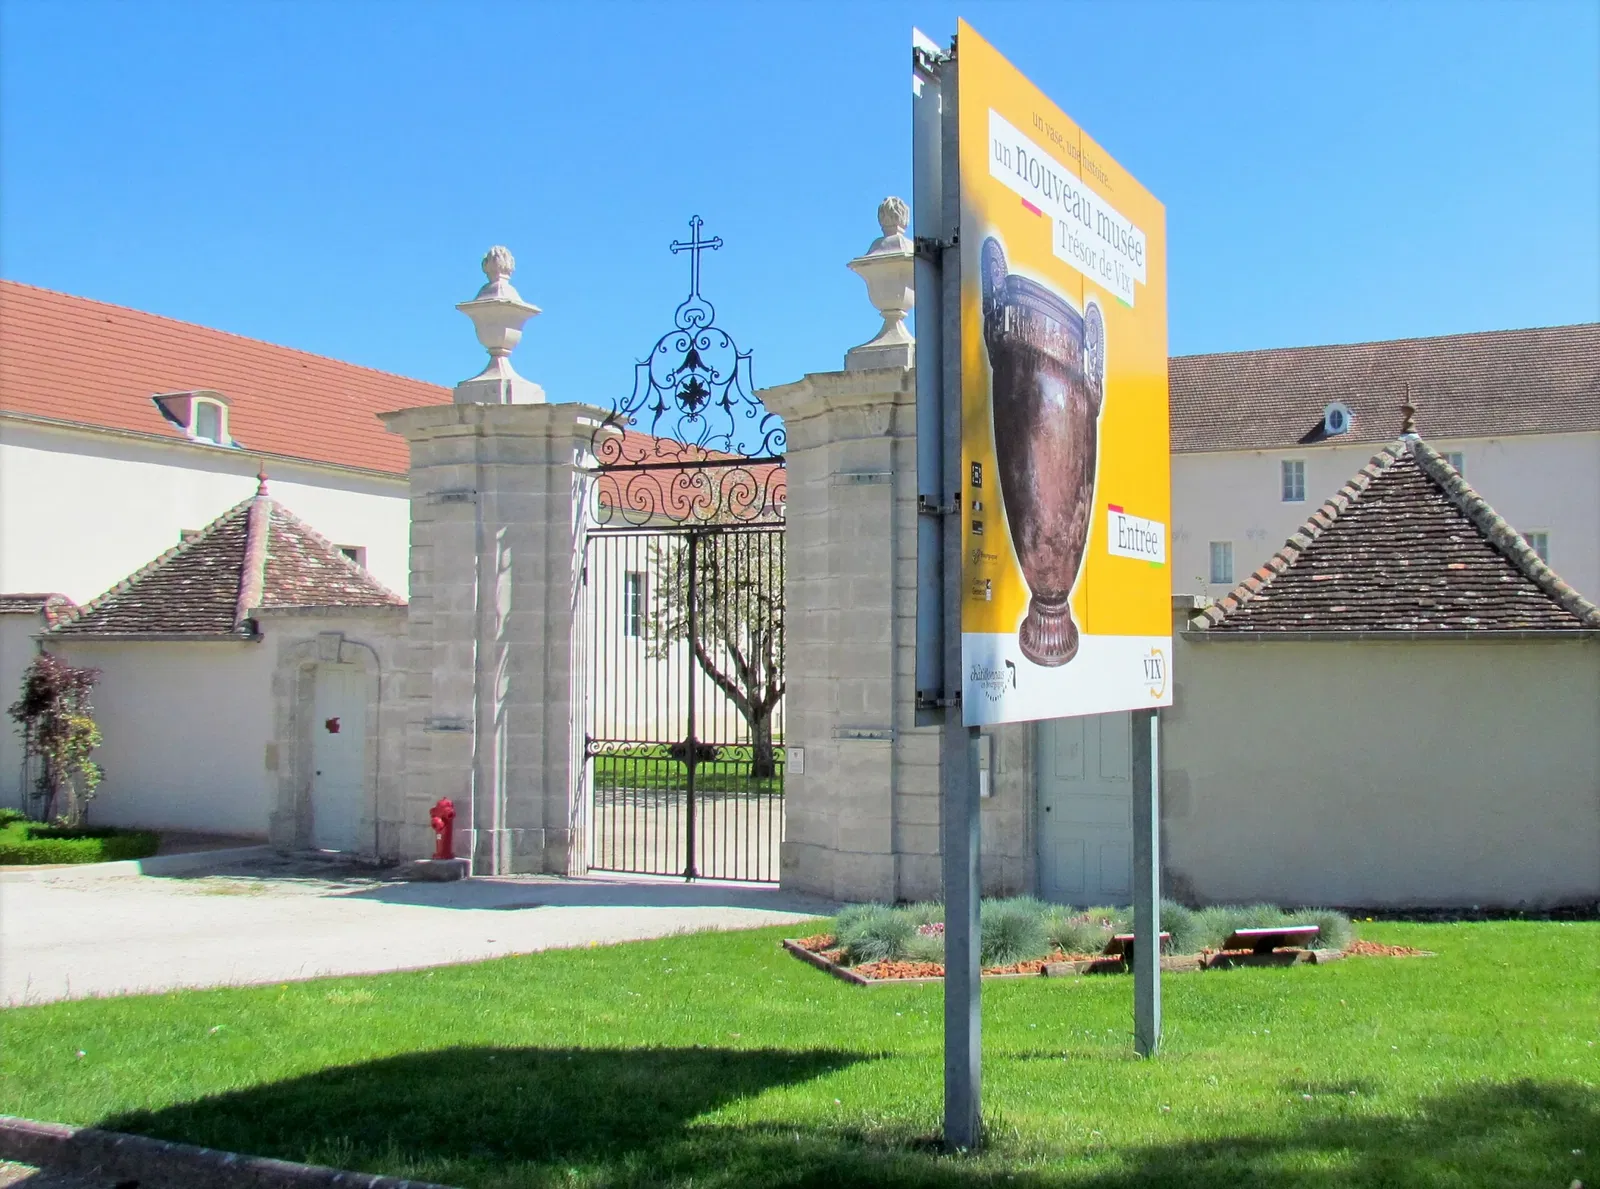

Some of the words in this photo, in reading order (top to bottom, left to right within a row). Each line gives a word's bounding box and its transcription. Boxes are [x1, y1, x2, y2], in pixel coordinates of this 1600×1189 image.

[1032, 111, 1044, 133] un
[1044, 122, 1066, 153] vase,
[1066, 141, 1081, 161] une
[993, 138, 1013, 170] un
[1015, 145, 1092, 229] nouveau
[1096, 208, 1143, 268] musée
[1058, 219, 1097, 270] Trésor
[1099, 248, 1113, 281] de
[1113, 259, 1132, 295] Vix
[1117, 515, 1158, 555] Entrée
[1143, 659, 1162, 680] VIX
